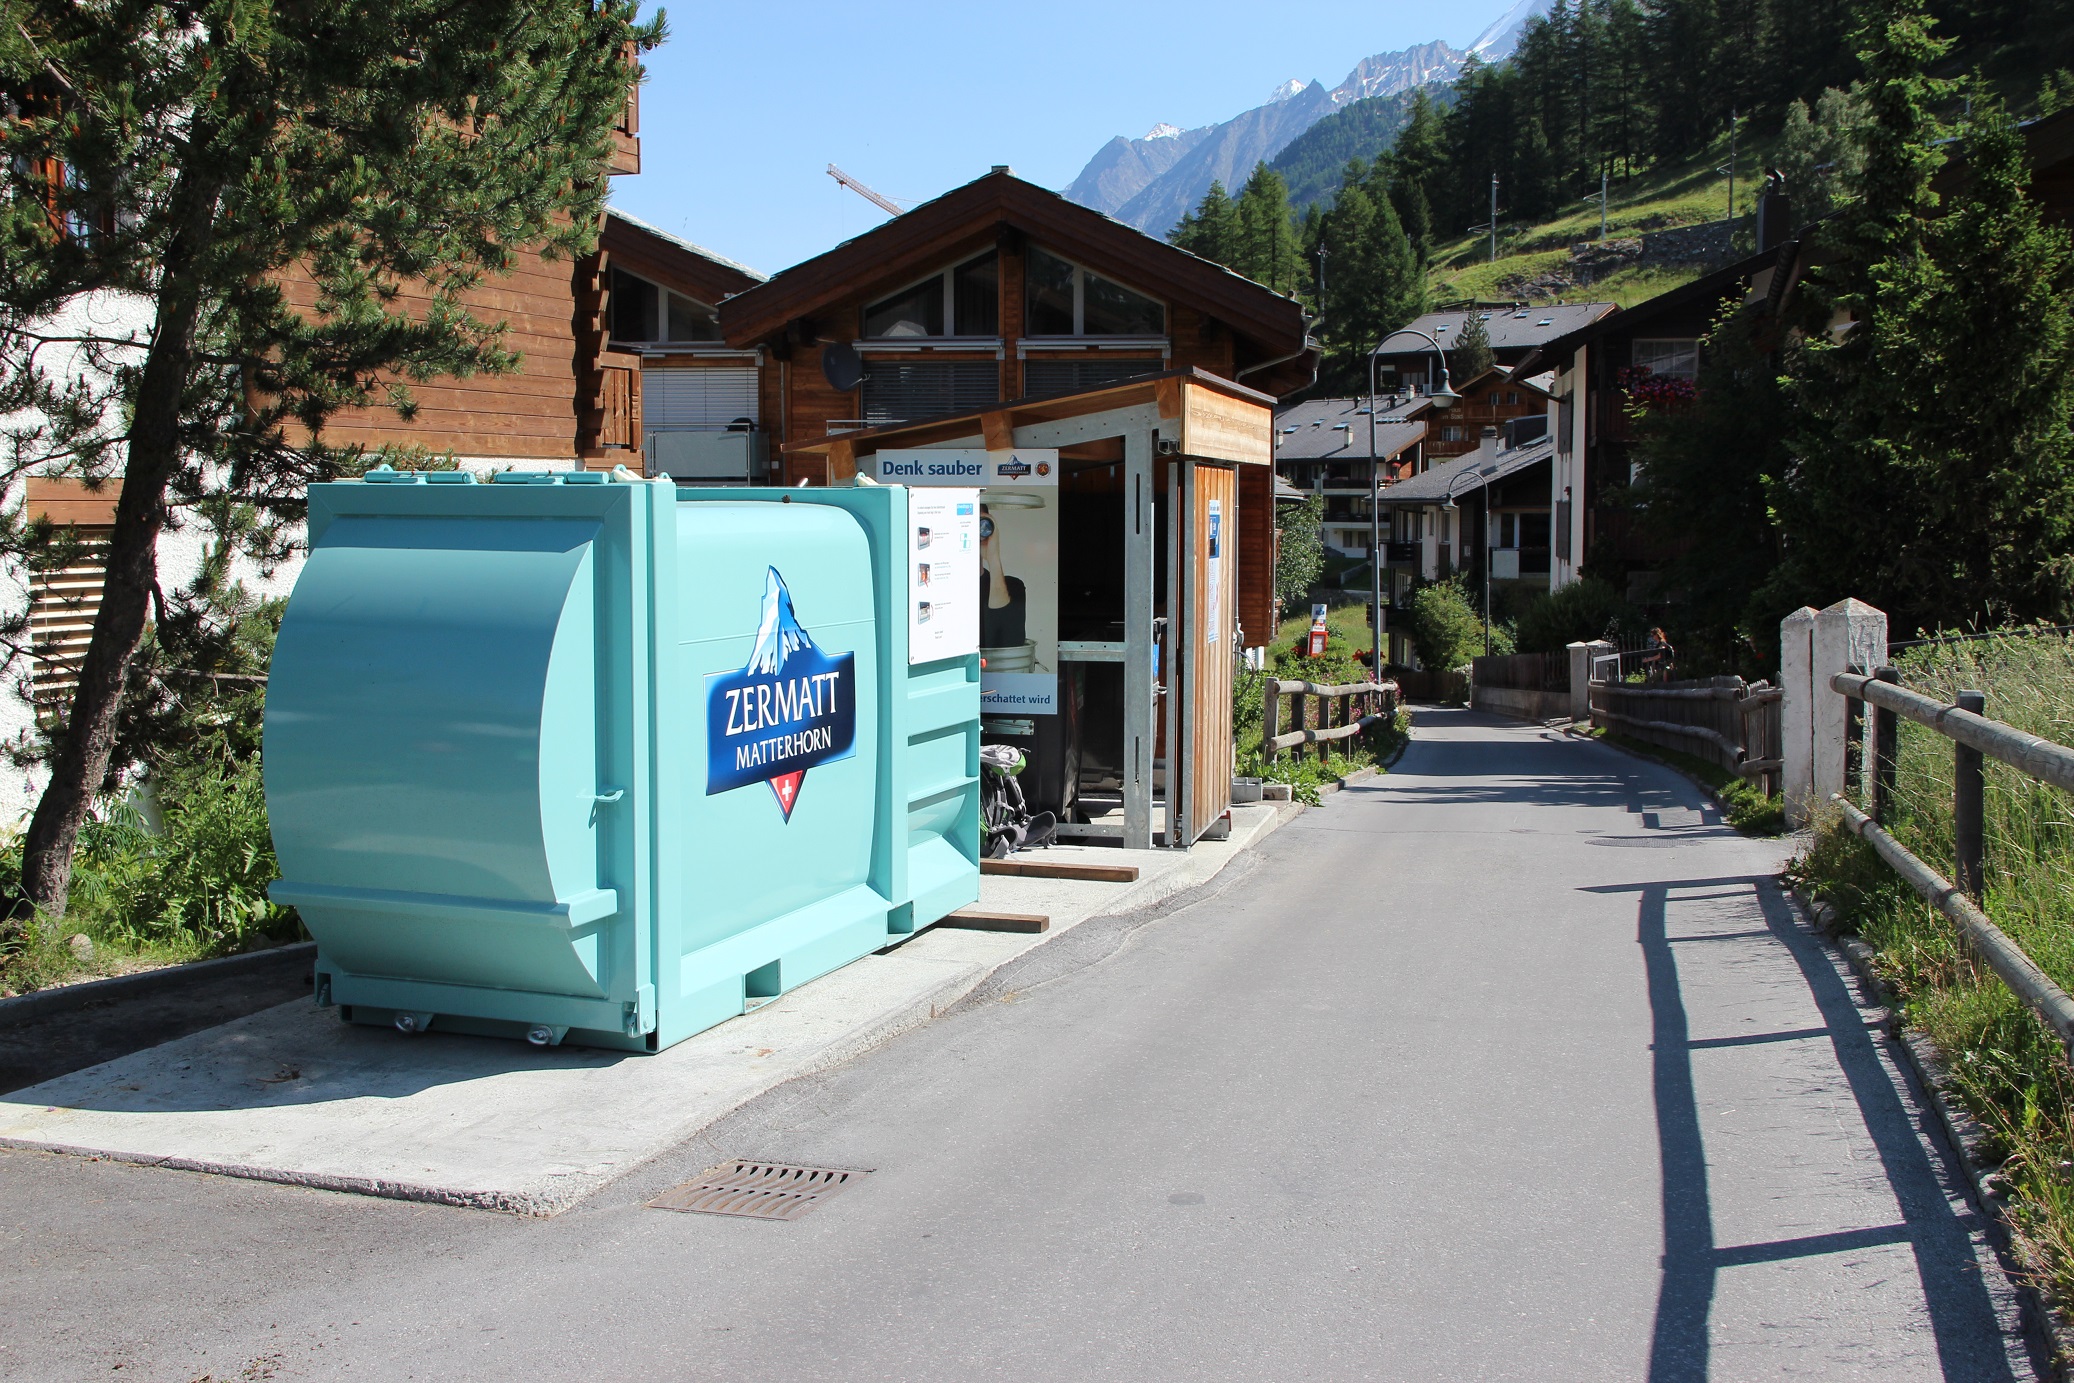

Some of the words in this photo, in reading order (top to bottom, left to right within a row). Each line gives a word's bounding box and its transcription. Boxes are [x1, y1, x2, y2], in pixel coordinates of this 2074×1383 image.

[883, 460, 923, 475] Denk
[928, 460, 982, 475] sauber
[725, 671, 840, 737] ZERMATT
[1028, 694, 1051, 704] wird
[735, 725, 832, 771] MATTERHORN
